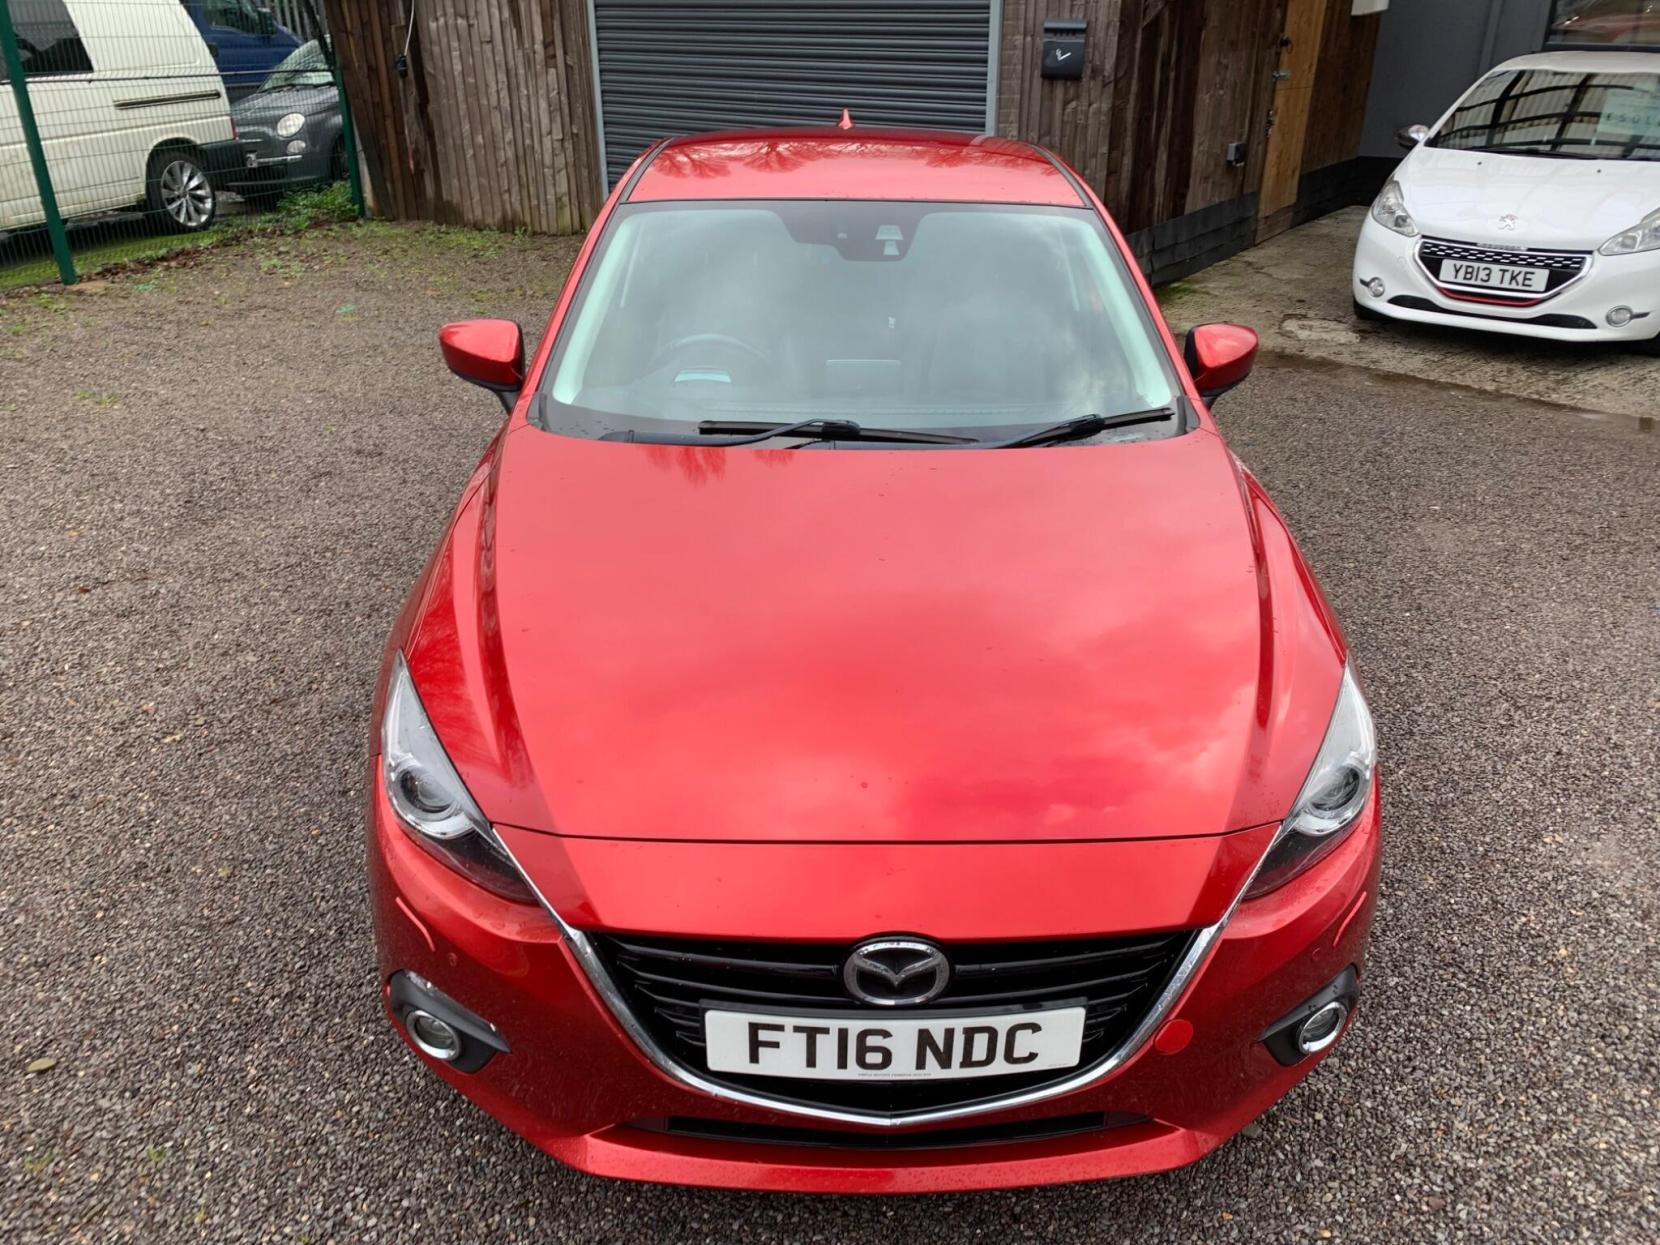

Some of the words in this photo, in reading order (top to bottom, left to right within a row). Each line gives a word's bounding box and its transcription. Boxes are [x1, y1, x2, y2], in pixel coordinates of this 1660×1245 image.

[1453, 264, 1492, 283] YB13
[1499, 269, 1535, 288] TKE
[748, 1022, 893, 1070] FT16
[915, 1022, 1042, 1070] NDC
